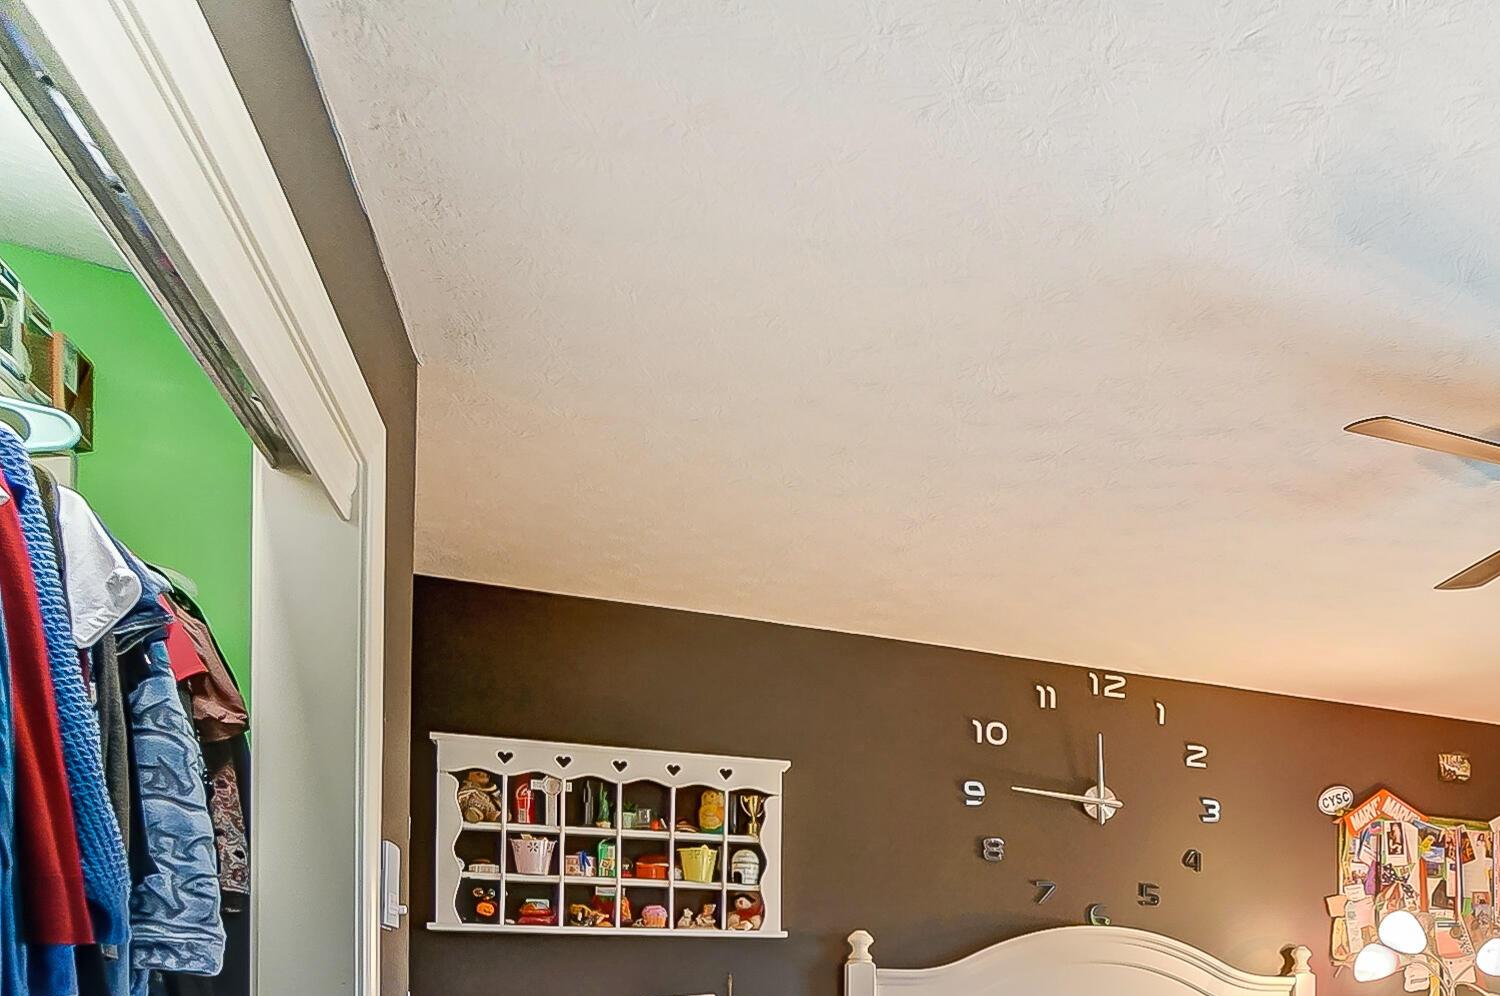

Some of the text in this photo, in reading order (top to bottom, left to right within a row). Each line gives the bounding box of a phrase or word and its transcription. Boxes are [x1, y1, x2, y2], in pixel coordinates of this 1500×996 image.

[1035, 684, 1057, 709] 11
[1088, 672, 1126, 699] 12
[1154, 702, 1166, 725] 1
[971, 719, 1008, 746] 10
[1185, 745, 1209, 769] 2
[962, 780, 986, 806] 9
[1322, 791, 1350, 809] CYSC
[1200, 798, 1222, 823] 3
[982, 837, 1005, 861] 8
[1182, 849, 1203, 872] 4
[1030, 880, 1056, 904] 7
[1137, 883, 1160, 907] 5
[1088, 903, 1111, 926] 6
